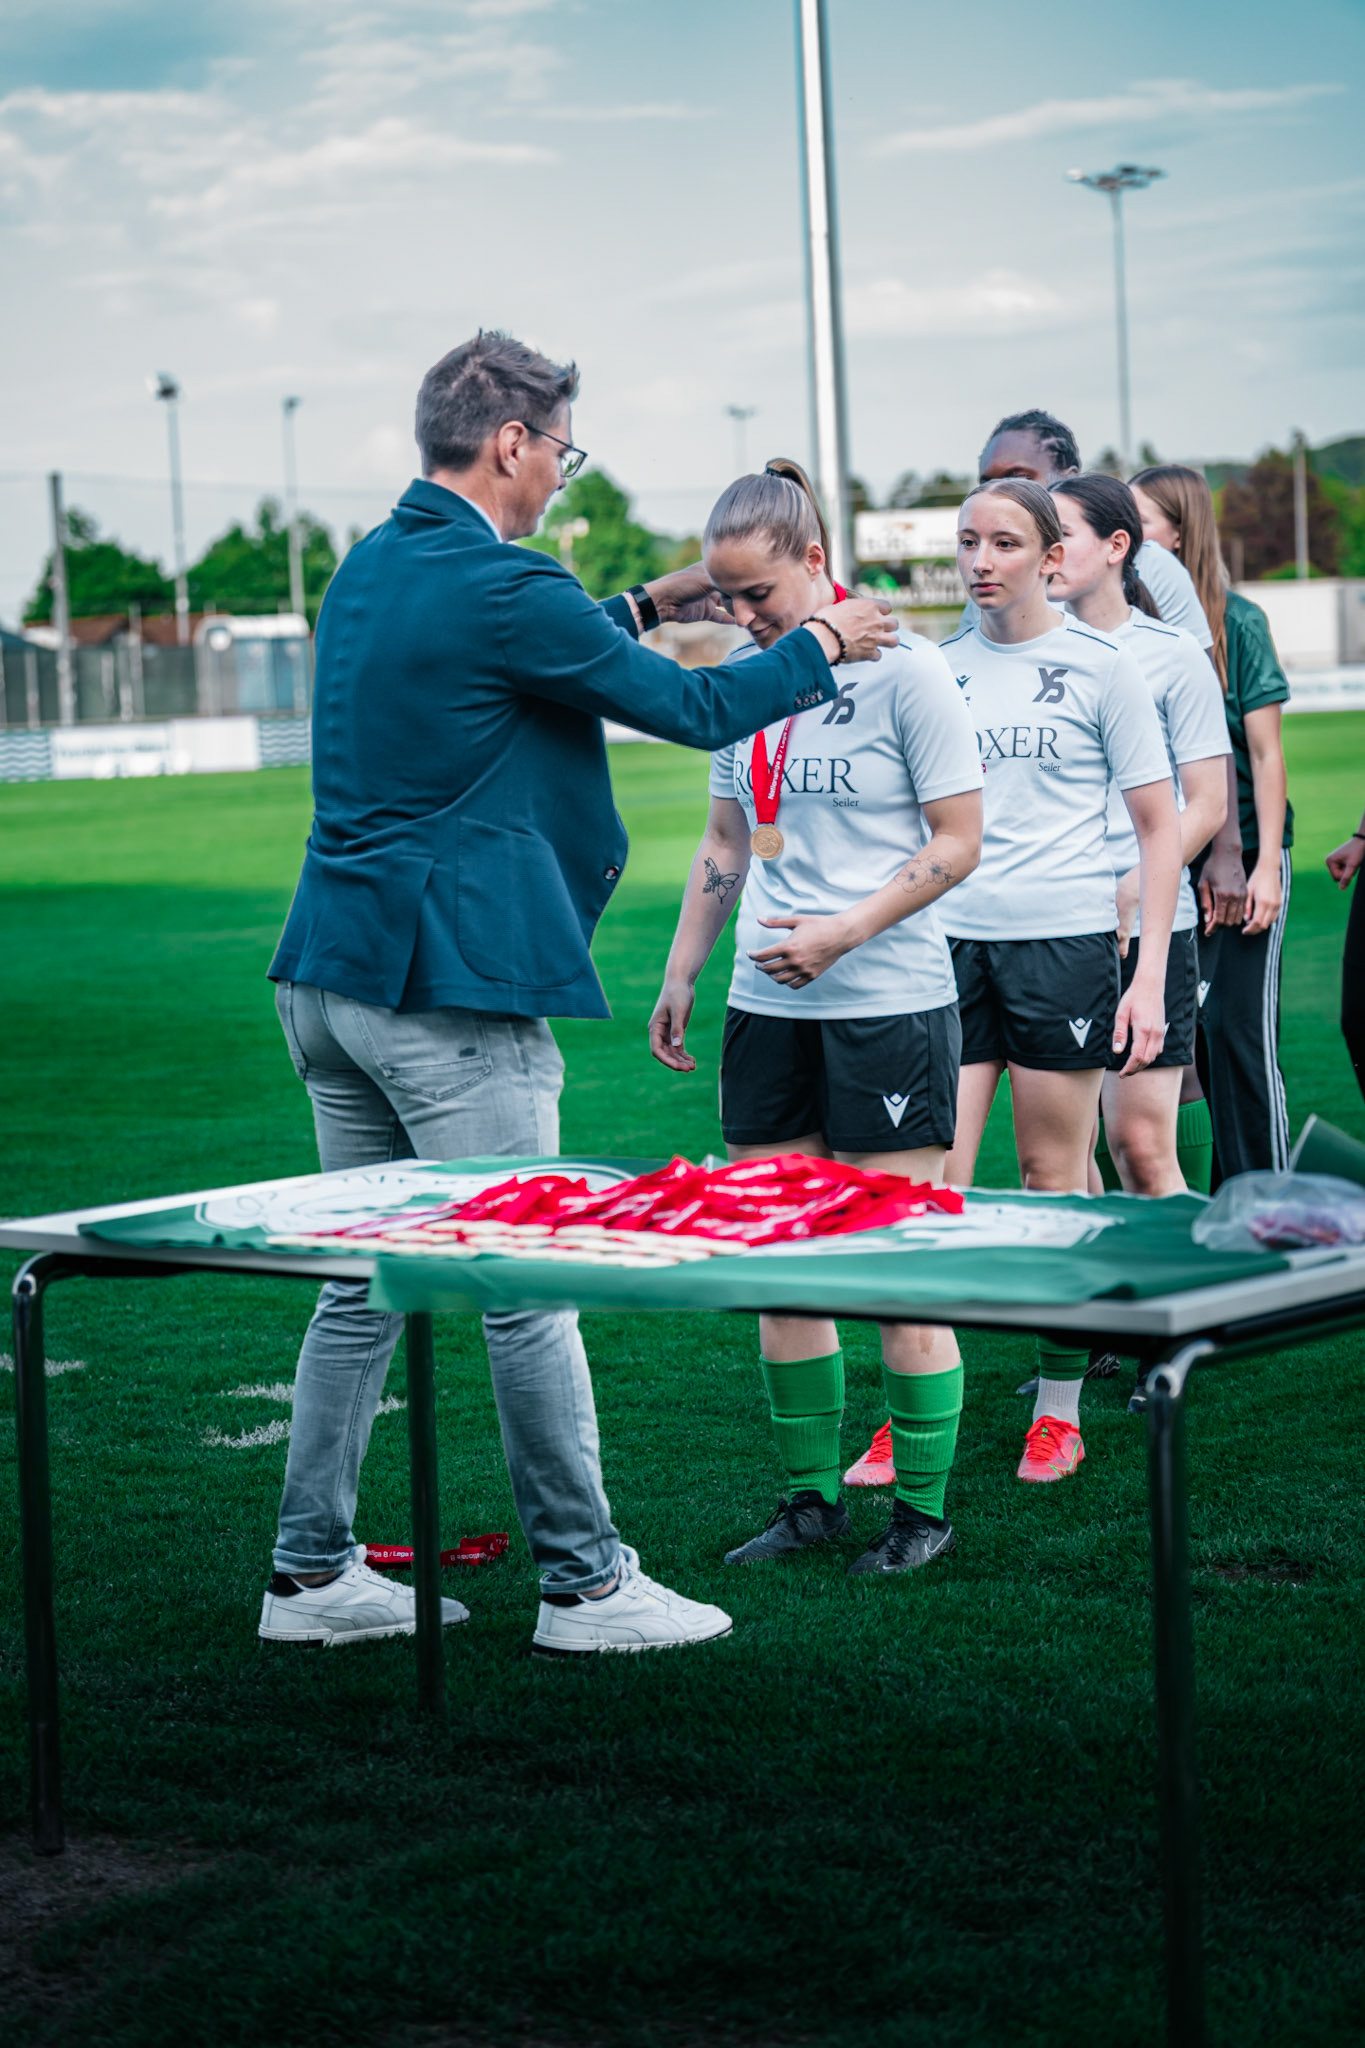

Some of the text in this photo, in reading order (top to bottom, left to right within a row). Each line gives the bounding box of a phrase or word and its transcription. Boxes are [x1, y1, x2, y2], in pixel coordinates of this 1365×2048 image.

[975, 726, 1062, 760] XER
[1038, 762, 1061, 772] Seiler
[832, 797, 859, 808] Seiler
